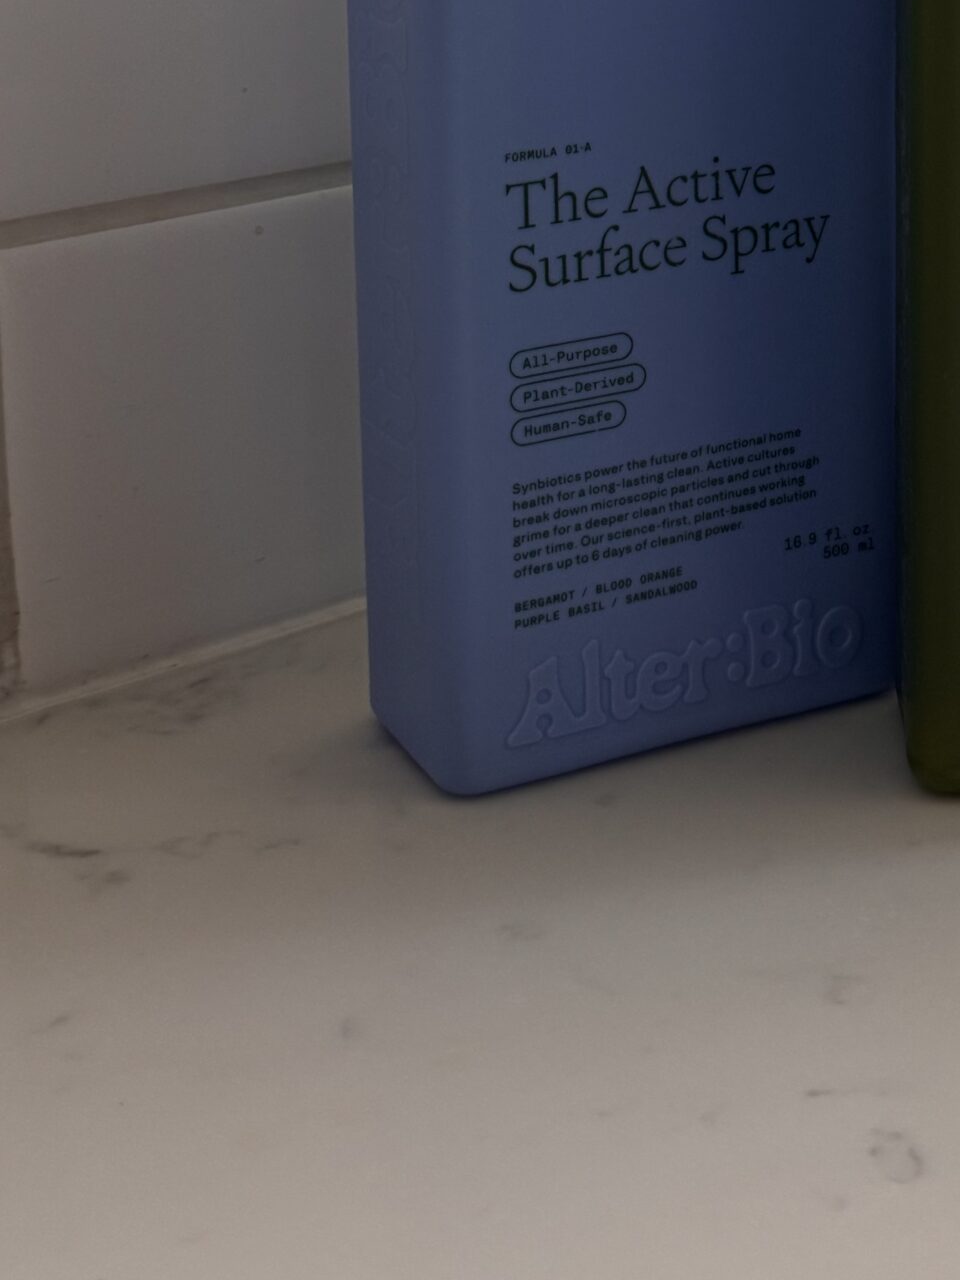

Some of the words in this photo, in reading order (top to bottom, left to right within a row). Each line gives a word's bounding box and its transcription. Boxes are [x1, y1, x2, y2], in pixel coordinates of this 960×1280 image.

[504, 146, 557, 163] FORMULA
[504, 172, 608, 230] The
[622, 156, 776, 214] Active
[508, 224, 687, 294] Surface
[702, 214, 831, 277] Spray
[522, 344, 618, 370] All-Purpose
[524, 371, 634, 404] Plant-Derived
[524, 410, 612, 437] Human-Safe
[512, 473, 582, 495] Synbiotics
[584, 464, 624, 482] power
[626, 459, 647, 471] the
[650, 451, 688, 466] future
[690, 446, 703, 458] of
[705, 434, 766, 454] functional
[769, 428, 802, 442] home
[512, 494, 554, 511] health
[557, 491, 575, 502] for
[578, 489, 586, 498] a
[589, 472, 664, 495] long-lasting
[706, 456, 744, 471] Active
[747, 446, 795, 462] cultures
[512, 530, 550, 548] grime
[553, 525, 571, 536] for
[574, 523, 582, 532] a
[585, 512, 629, 530] deeper
[632, 506, 665, 519] clean
[669, 498, 693, 512] that
[697, 486, 756, 506] continues
[758, 475, 806, 492] working
[513, 512, 550, 528] break
[553, 505, 588, 520] down
[591, 488, 667, 511] microscopic
[671, 477, 724, 497] particles
[727, 470, 749, 483] and
[752, 466, 771, 478] cut
[774, 456, 820, 473] through
[513, 548, 542, 562] over
[581, 534, 604, 547] Our
[694, 497, 767, 525] plant-based
[769, 490, 816, 506] solution
[513, 562, 554, 579] offers
[556, 558, 573, 570] up
[574, 554, 589, 565] to
[591, 550, 600, 562] 6
[602, 545, 632, 559] days
[635, 539, 647, 552] of
[650, 530, 702, 548] cleaning
[822, 542, 850, 559] 500
[858, 537, 874, 552] ml
[514, 590, 575, 613] BERGAMOT
[595, 578, 632, 594] BLOOD
[640, 566, 682, 584] ORANGE
[514, 610, 560, 630] PURPLE
[568, 600, 605, 618] BASIL
[625, 580, 698, 604] SANDALWOOD
[505, 598, 863, 748] Alter:Bio
